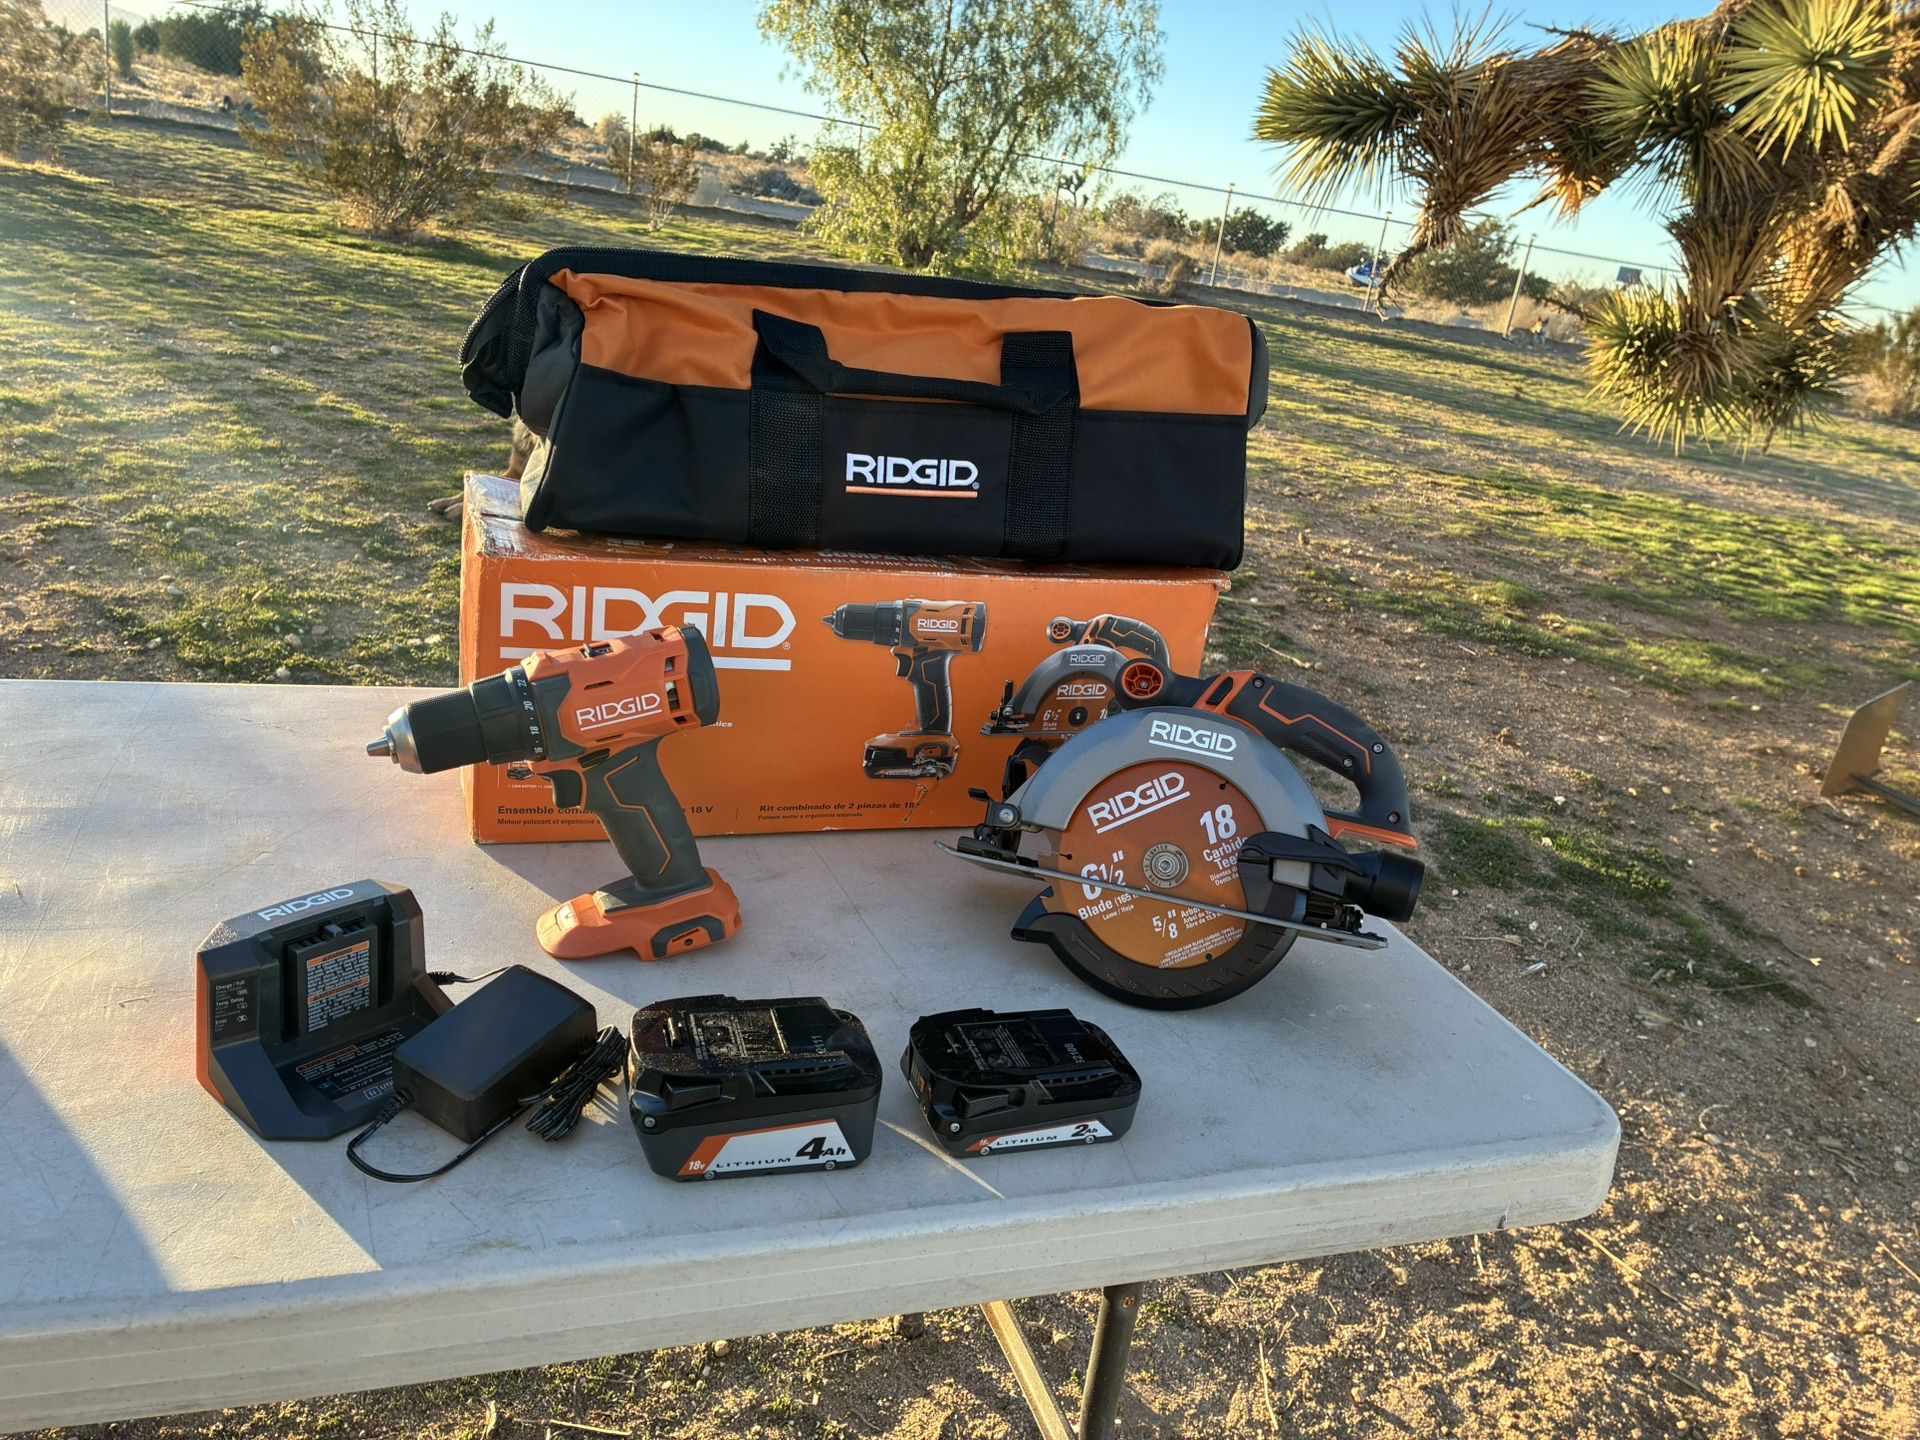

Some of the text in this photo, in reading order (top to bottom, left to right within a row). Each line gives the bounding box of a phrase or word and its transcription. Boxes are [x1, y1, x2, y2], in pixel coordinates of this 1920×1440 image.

[846, 453, 979, 486] RIDGID
[500, 582, 797, 649] RIDGID
[918, 618, 959, 629] RIDGID
[1069, 654, 1107, 663] RIDGID
[1057, 684, 1107, 696] RIDGID
[576, 693, 661, 726] RIDGID
[1150, 720, 1238, 753] RIDGID
[497, 806, 554, 814] Ensemble
[690, 806, 702, 814] 18
[777, 803, 831, 812] combinado
[857, 802, 887, 810] piezas
[1087, 772, 1185, 827] RIDGID
[1200, 804, 1237, 845] 18
[257, 888, 354, 921] RIDGID
[1078, 899, 1113, 921] Blade
[997, 1135, 1057, 1146] LITHIUM
[1071, 1123, 1098, 1137] 2Ah
[795, 1137, 846, 1160] 4Ah
[716, 1157, 791, 1168] LITHIUM
